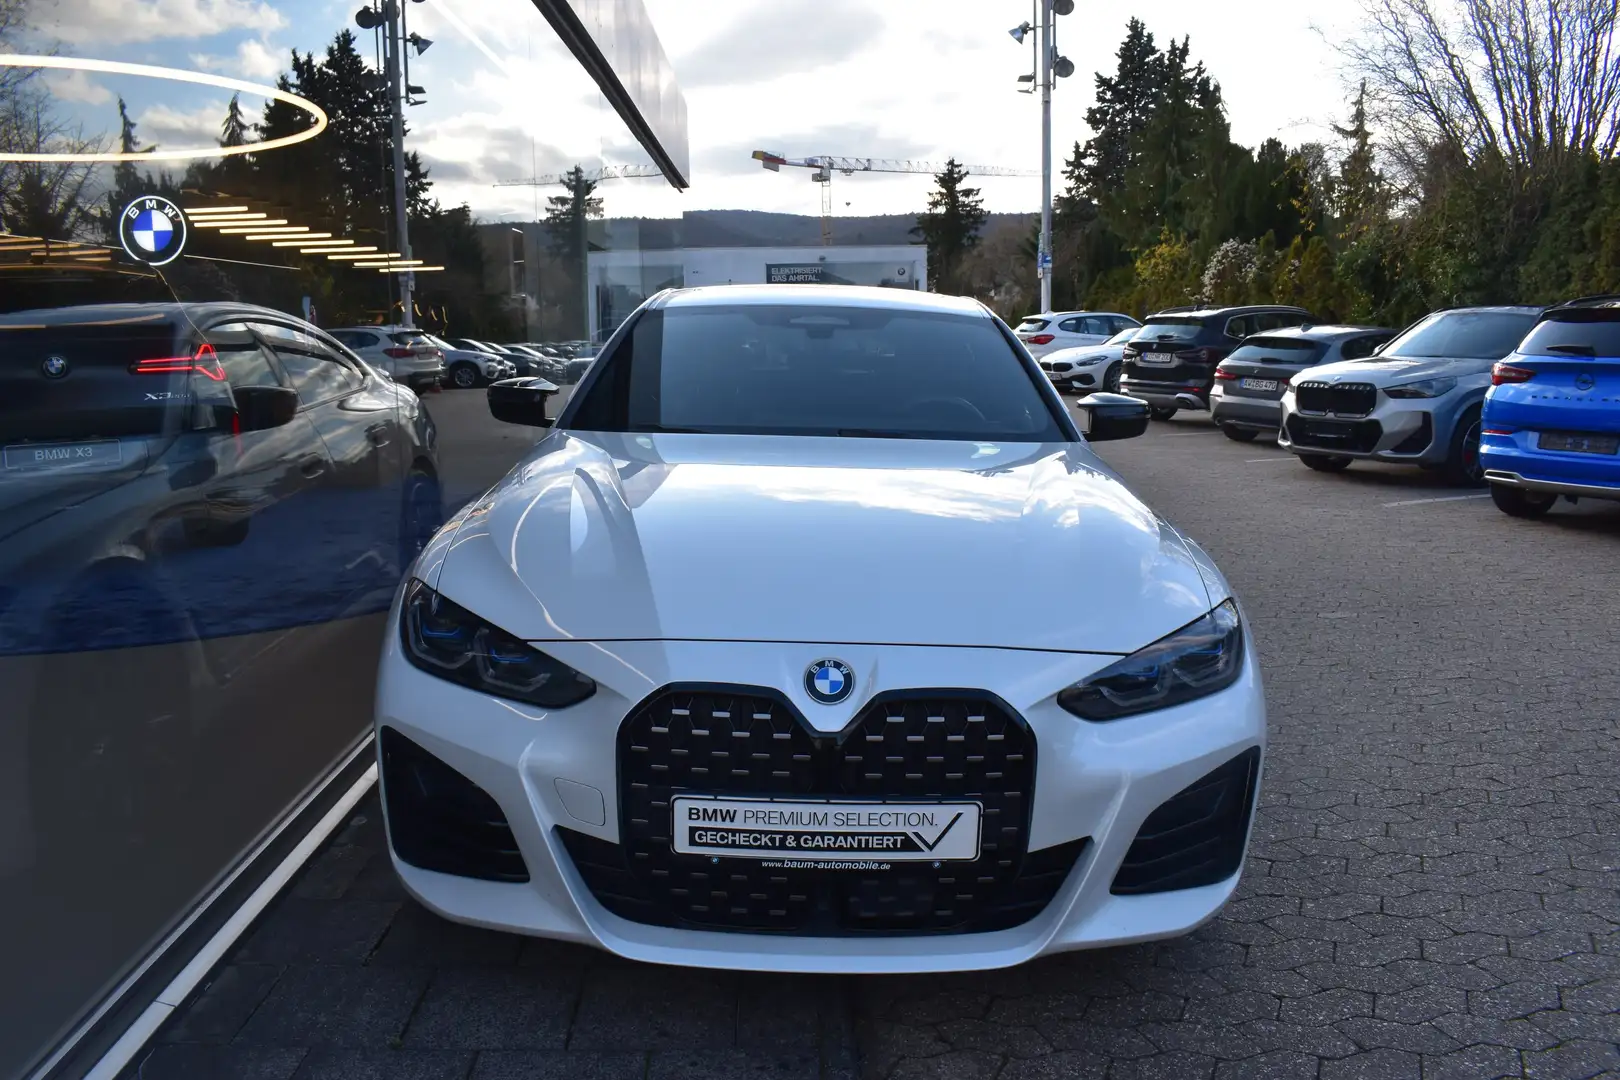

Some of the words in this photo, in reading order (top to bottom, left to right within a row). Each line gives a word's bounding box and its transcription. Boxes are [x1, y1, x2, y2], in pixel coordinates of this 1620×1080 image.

[771, 267, 822, 275] ELEKTRISIERT
[788, 274, 820, 282] AHRTAL.
[35, 449, 70, 460] BMW
[75, 447, 93, 457] X3
[688, 806, 737, 823] BMW
[744, 809, 828, 826] PREMIUM
[833, 812, 938, 827] SELECTION.
[694, 830, 783, 847] GECHECKT
[785, 834, 797, 847] &
[800, 835, 905, 848] GARANTIERT
[761, 859, 891, 870] www.baum-automobile.de
